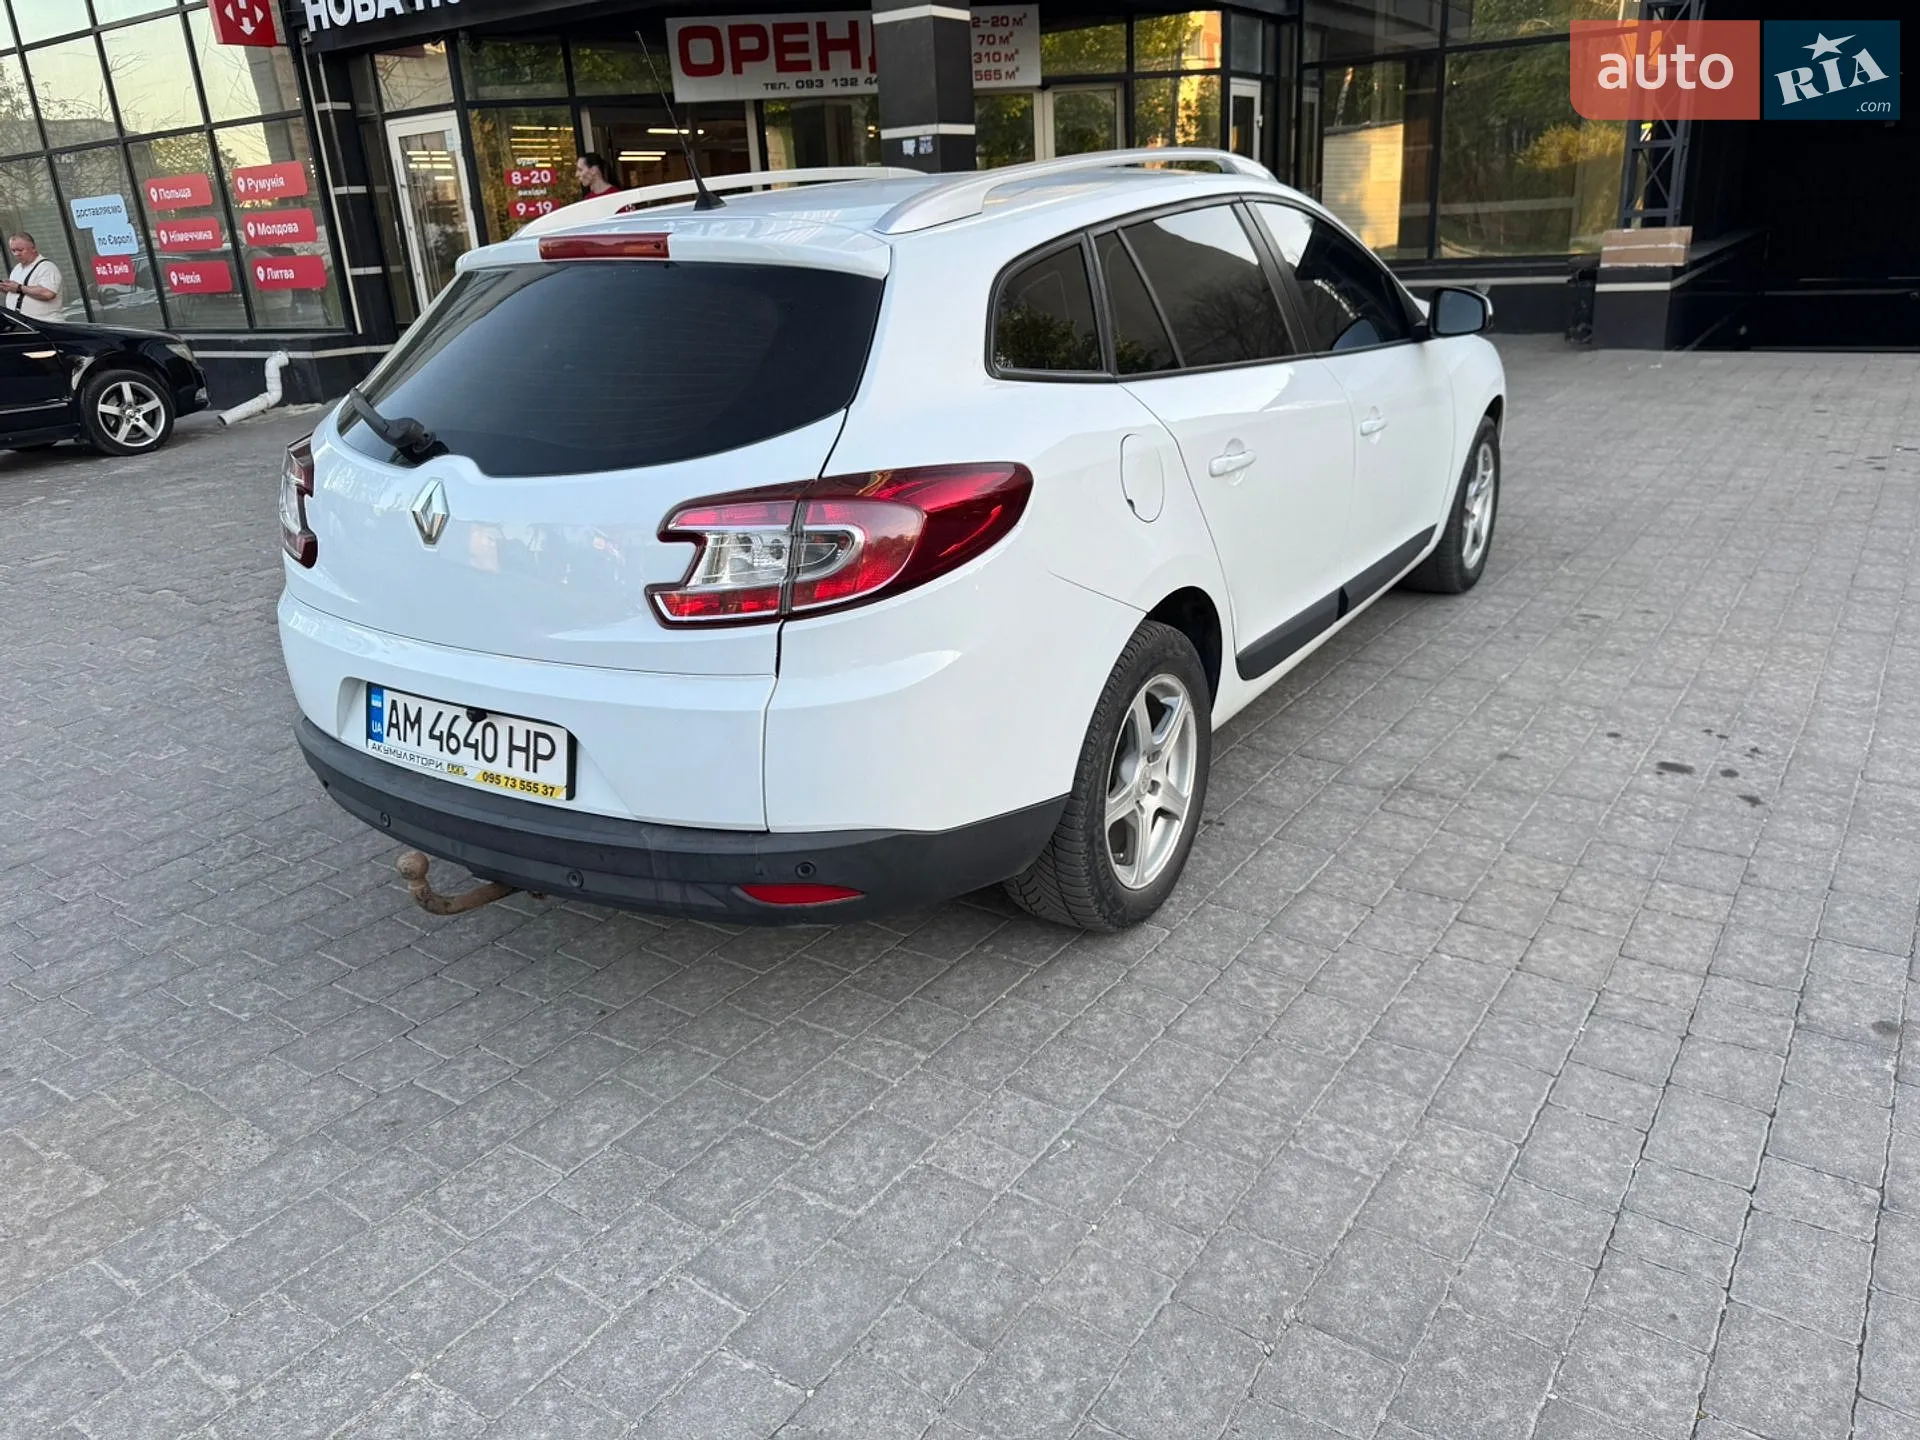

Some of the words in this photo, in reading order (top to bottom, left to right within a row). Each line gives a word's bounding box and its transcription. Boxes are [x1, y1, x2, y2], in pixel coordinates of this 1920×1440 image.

[977, 33, 996, 45] 70
[678, 20, 877, 77] ОРЕН
[974, 51, 1002, 63] 310
[795, 78, 825, 89] 093
[832, 77, 859, 88] 132
[247, 174, 285, 191] Румунія
[511, 170, 551, 185] 8-20
[158, 187, 192, 201] Польща
[516, 201, 553, 216] 9-19
[169, 229, 214, 243] Німеччина
[256, 221, 299, 237] Молдова
[107, 263, 112, 275] 3
[266, 267, 295, 281] Литва
[178, 271, 202, 285] Чехія
[371, 719, 383, 735] UA
[386, 699, 423, 747] AM
[428, 711, 498, 764] 4640
[507, 725, 556, 774] HP
[371, 742, 443, 769] АКУМУЛЯТОРИ
[482, 771, 501, 786] 095
[503, 776, 517, 789] 73
[519, 780, 539, 793] 555
[541, 785, 555, 797] 37
